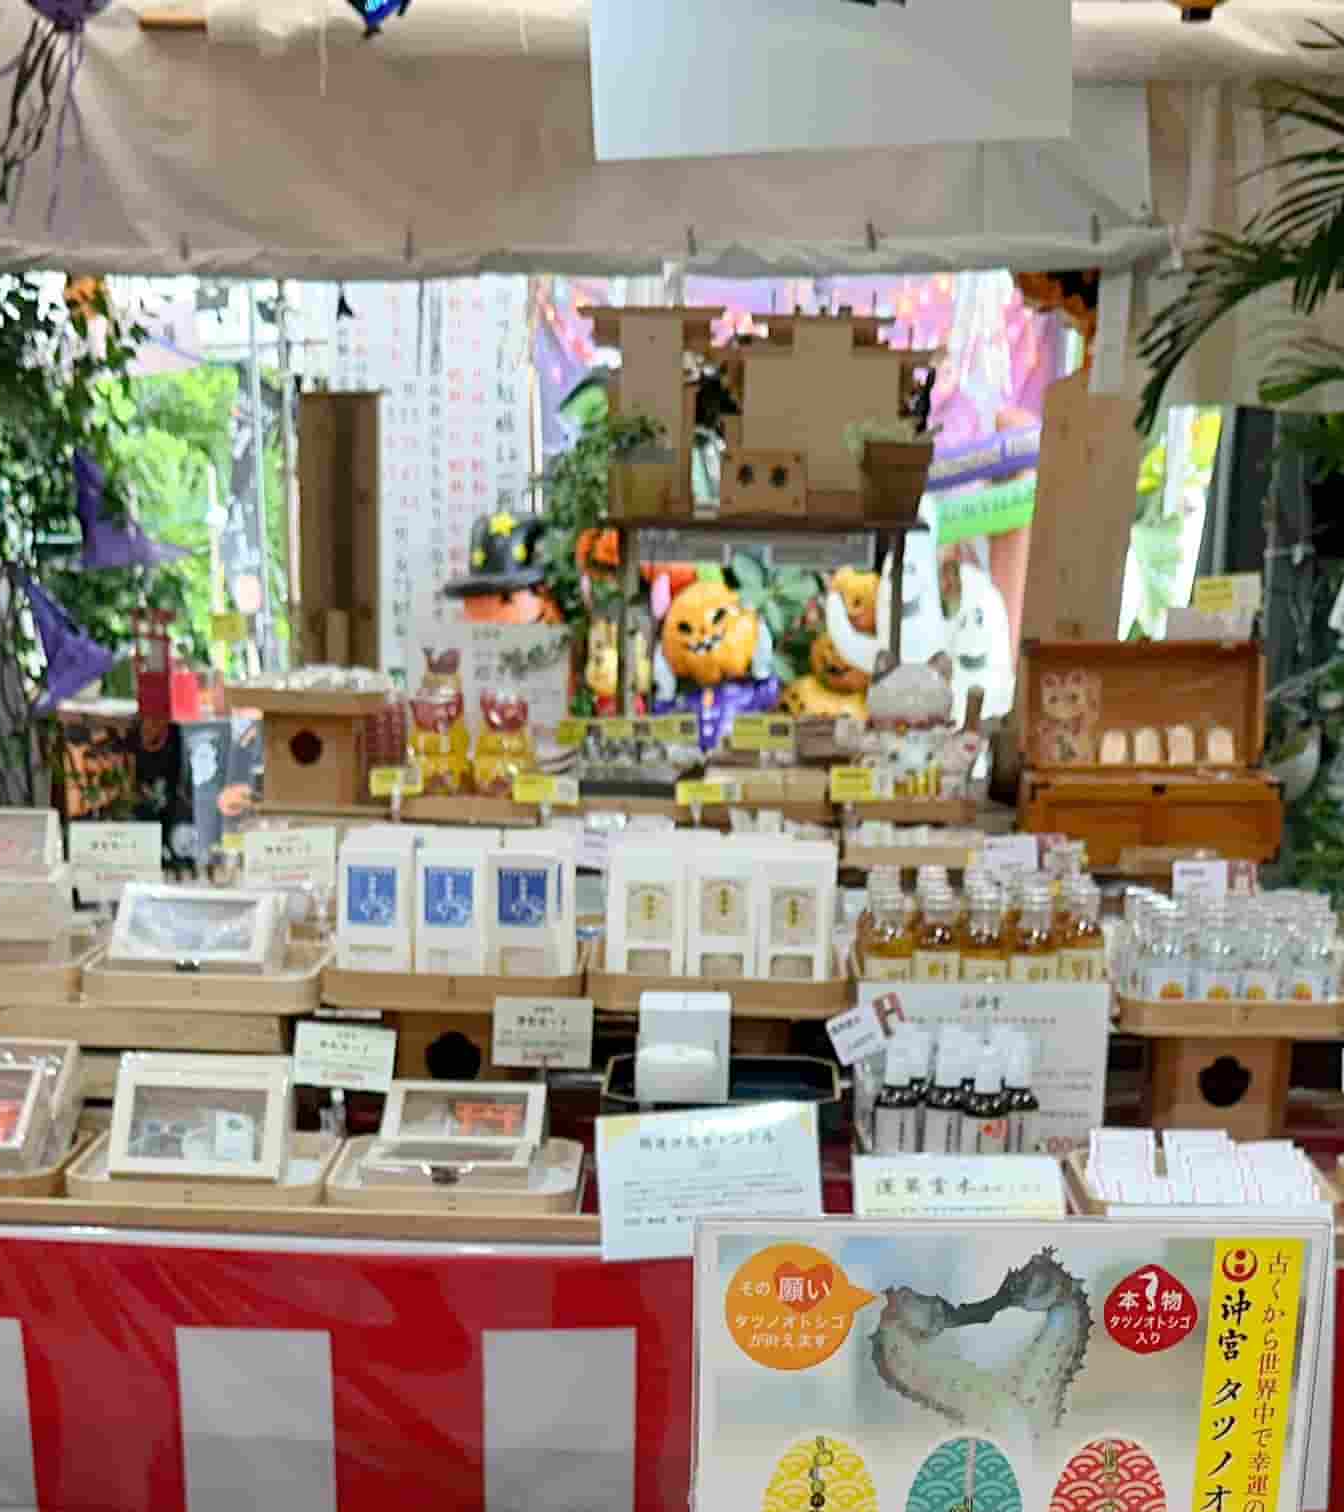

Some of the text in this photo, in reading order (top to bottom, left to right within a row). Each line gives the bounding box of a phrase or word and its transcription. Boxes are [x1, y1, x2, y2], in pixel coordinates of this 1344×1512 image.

[1110, 1315, 1193, 1330] タツノオトシゴ
[1135, 1332, 1161, 1345] 入り
